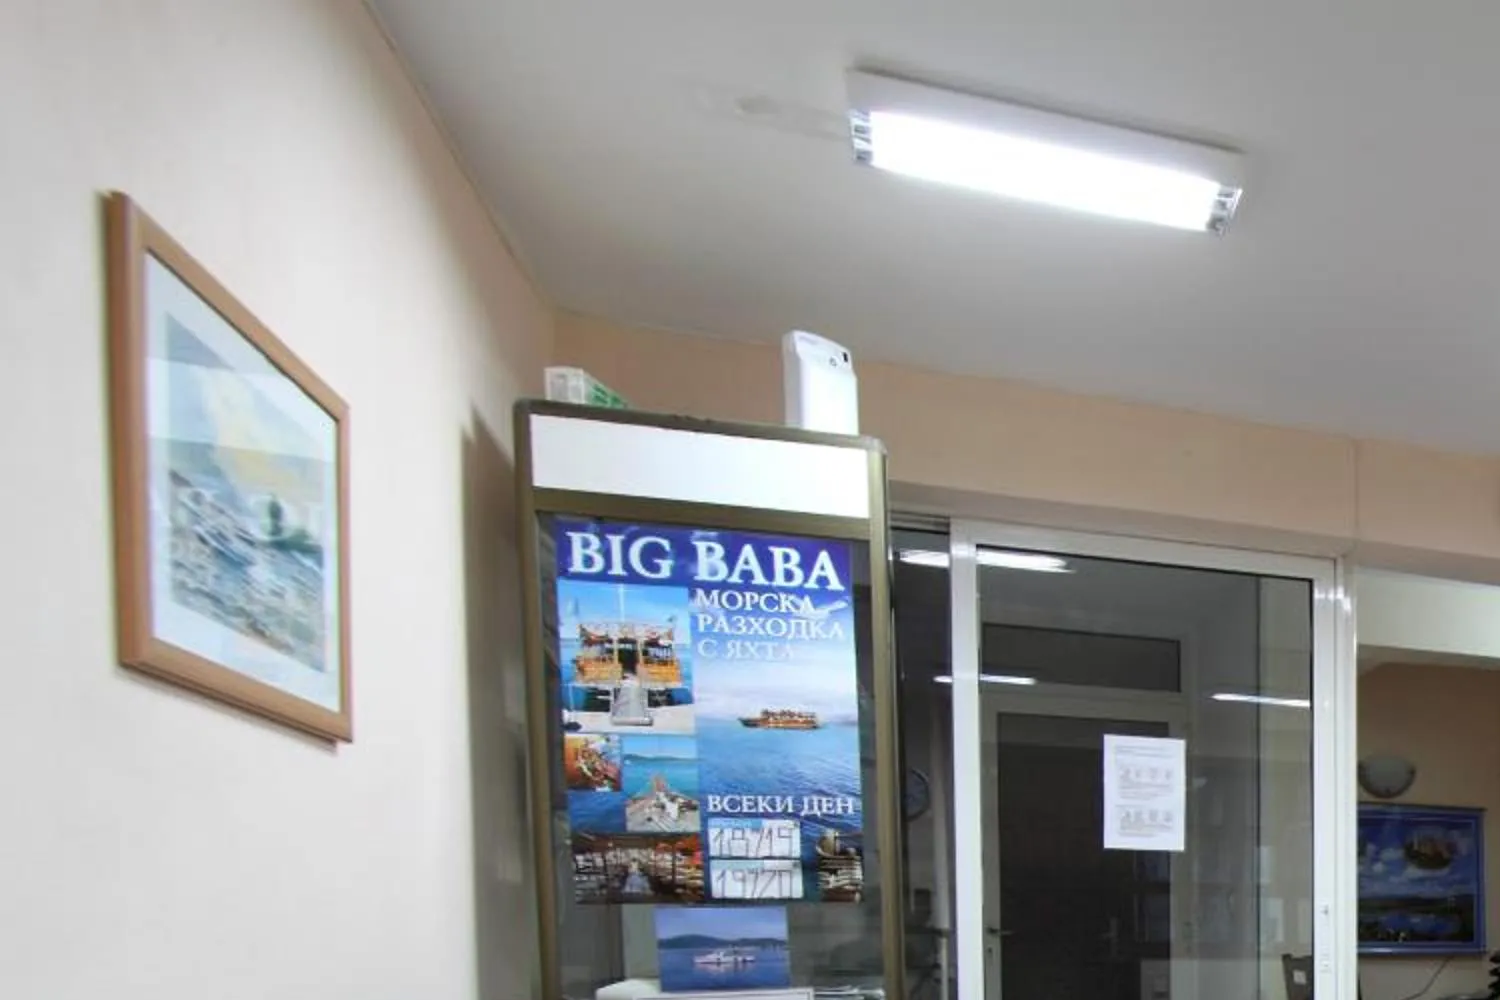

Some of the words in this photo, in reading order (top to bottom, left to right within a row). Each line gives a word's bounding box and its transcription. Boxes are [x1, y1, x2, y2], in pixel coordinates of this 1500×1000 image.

[565, 531, 674, 579] BIG
[691, 541, 845, 591] BABA
[694, 588, 817, 613] МОРСКА
[697, 613, 845, 641] РАЗХОДКА
[698, 637, 717, 658] С
[707, 795, 793, 813] ВСЕКИ
[801, 796, 855, 817] ДЕН
